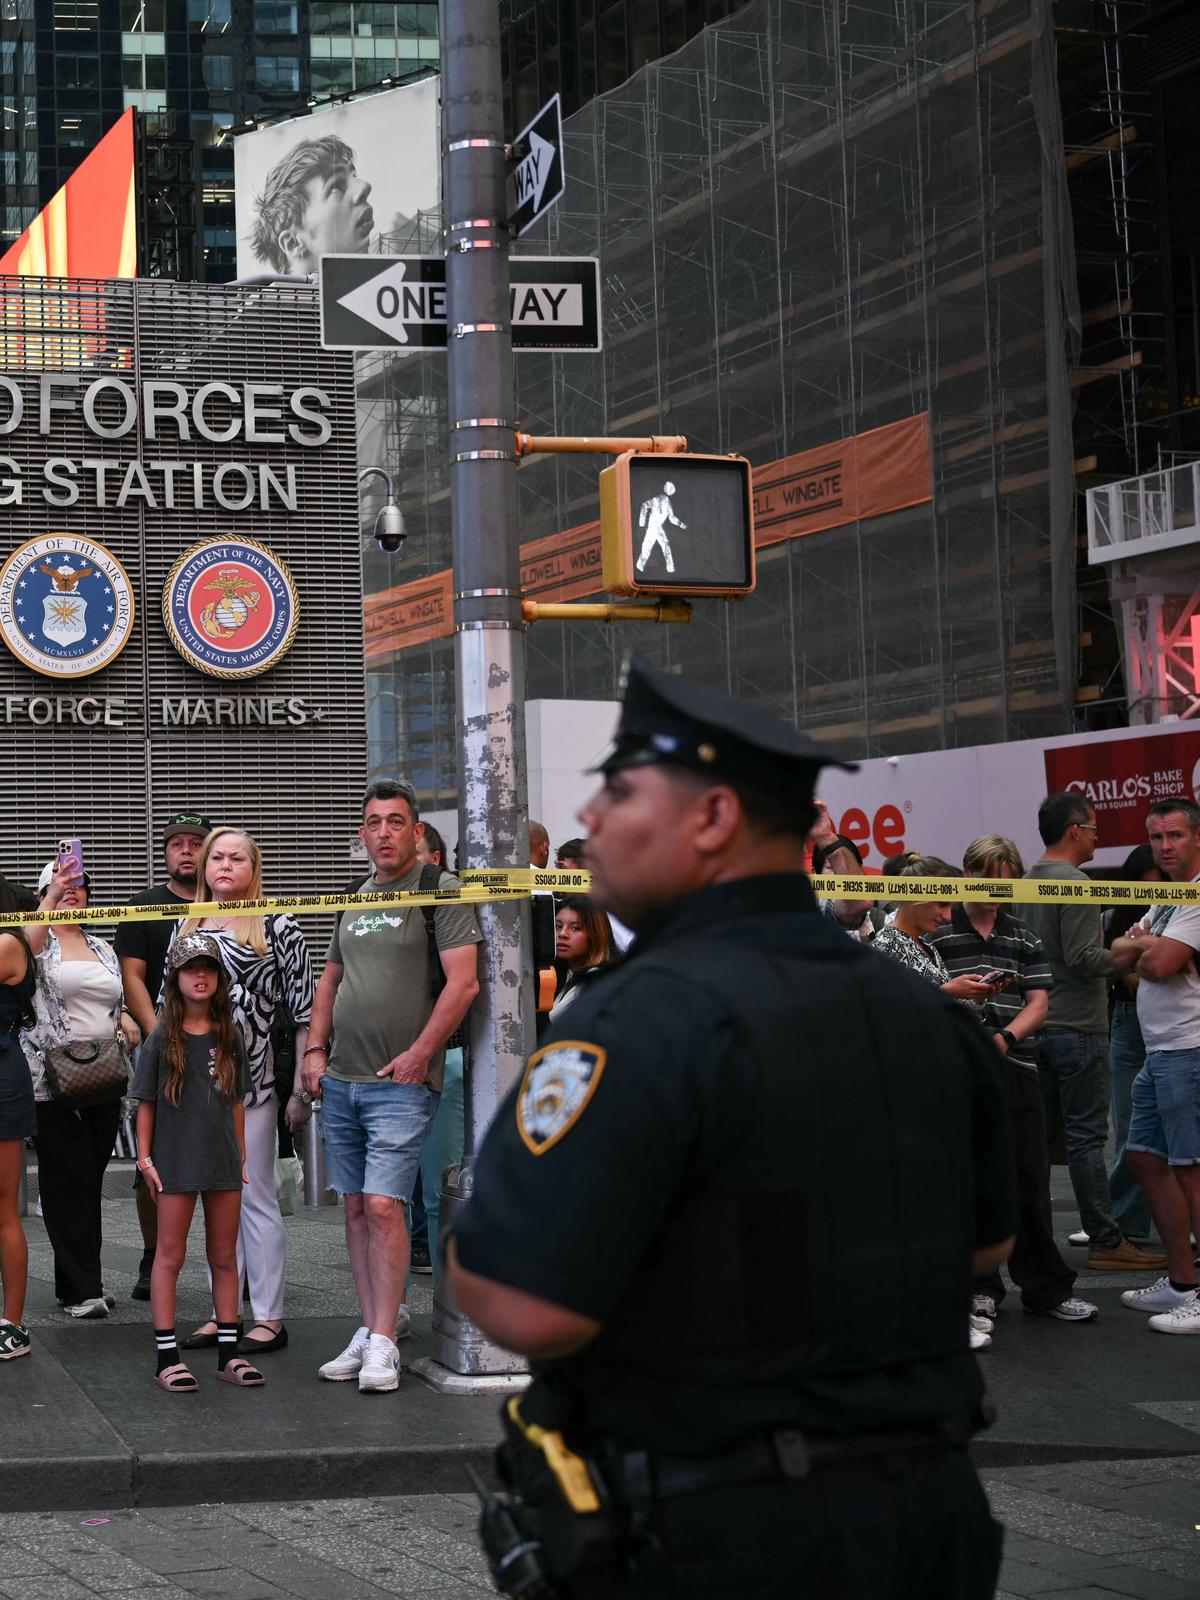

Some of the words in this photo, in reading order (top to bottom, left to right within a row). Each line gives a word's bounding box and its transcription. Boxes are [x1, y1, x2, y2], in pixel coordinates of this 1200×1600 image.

[514, 147, 541, 206] WAY
[376, 284, 447, 321] ONE
[511, 287, 569, 322] AY
[39, 375, 332, 446] FORCES
[42, 457, 298, 512] STATION
[782, 474, 842, 506] WINGATE
[175, 548, 230, 607] DEPARTMENT
[232, 549, 244, 558] OF
[245, 552, 264, 568] THE
[263, 566, 286, 599] NAVY
[0, 544, 38, 625] DEPARTMENT
[45, 538, 64, 550] OF
[72, 539, 99, 560] THE
[101, 560, 121, 583] AIR
[114, 589, 129, 634] FORCE
[178, 617, 205, 654] UNITED
[204, 650, 238, 664] STATES
[241, 640, 274, 664] MARINE
[271, 610, 286, 640] CORPS
[12, 635, 35, 659] UNITED
[38, 657, 64, 670] STATES
[86, 642, 116, 666] AMERICA
[5, 697, 125, 726] FORCE
[162, 698, 307, 726] MARINES
[1153, 768, 1183, 783] BAKE
[1153, 782, 1185, 796] SHOP
[1094, 801, 1108, 811] MES
[1108, 799, 1137, 809] SQUARE
[535, 874, 557, 885] CROSS
[558, 874, 571, 886] NOT
[572, 874, 582, 886] DO
[826, 880, 836, 891] DO
[843, 881, 863, 892] SCENE
[864, 882, 885, 893] CRIME
[888, 882, 908, 894] (8477)
[909, 883, 959, 895] 1-800-577-TIPS
[1038, 885, 1059, 896] CROSS
[1060, 885, 1073, 896] NOT
[1074, 885, 1083, 896] DO
[1090, 886, 1109, 897] SCENE
[1111, 886, 1131, 898] CRIME
[1134, 886, 1154, 899] (8477)
[324, 894, 347, 906] (8477)
[1155, 888, 1200, 900] -800-577-TIPS
[275, 898, 297, 907] SCENE
[299, 897, 321, 906] CRIME
[22, 911, 45, 923] CRIME
[49, 909, 71, 922] (8477)
[72, 908, 128, 921] 1-800-577-TIPS
